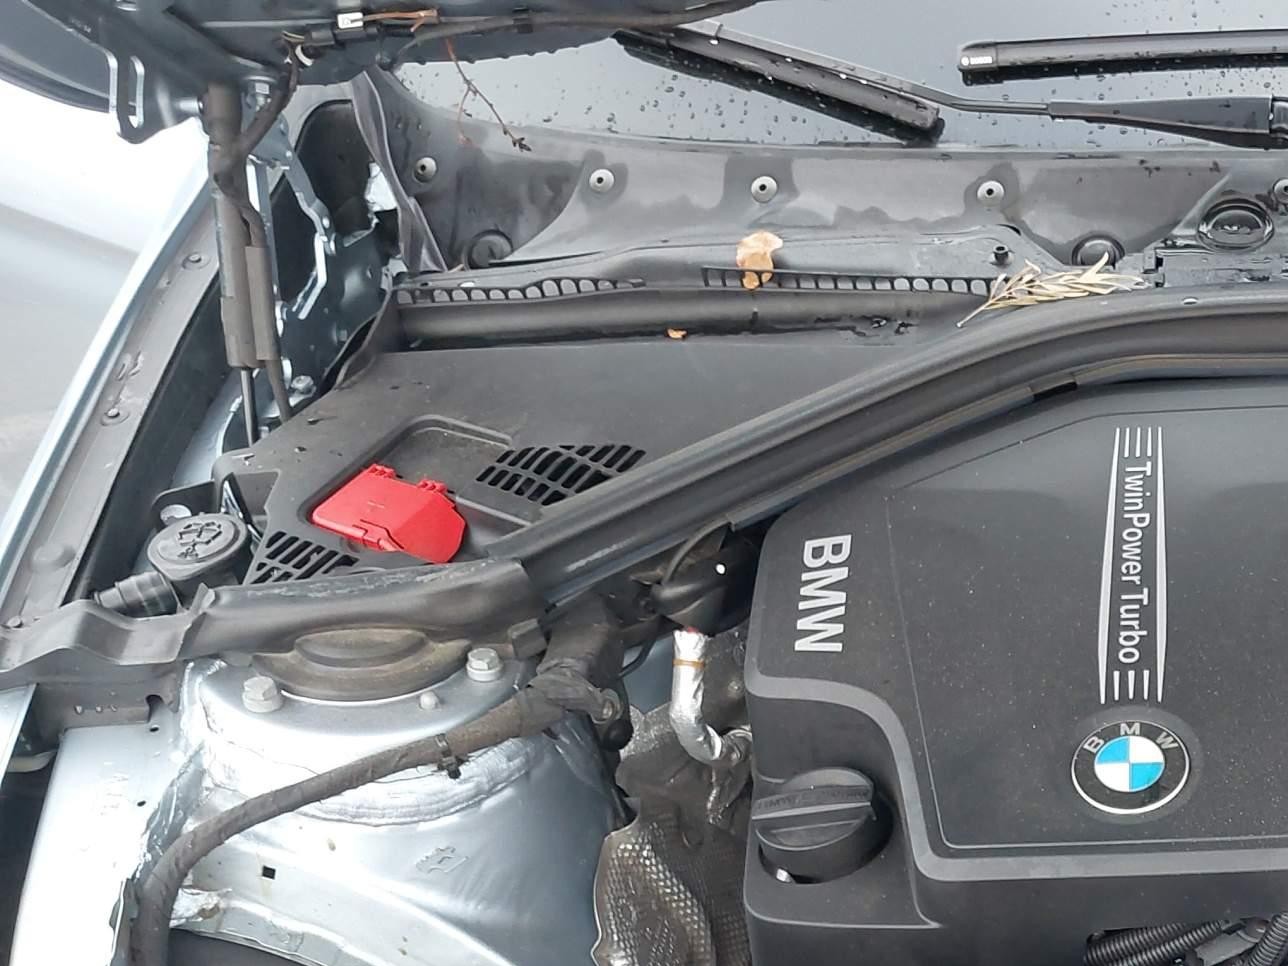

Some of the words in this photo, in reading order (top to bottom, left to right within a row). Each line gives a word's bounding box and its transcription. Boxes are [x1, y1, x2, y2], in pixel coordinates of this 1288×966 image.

[1120, 461, 1152, 585] TwinPower
[794, 534, 852, 652] BMW
[1117, 587, 1150, 665] Turbo
[1082, 721, 1179, 754] BMW
